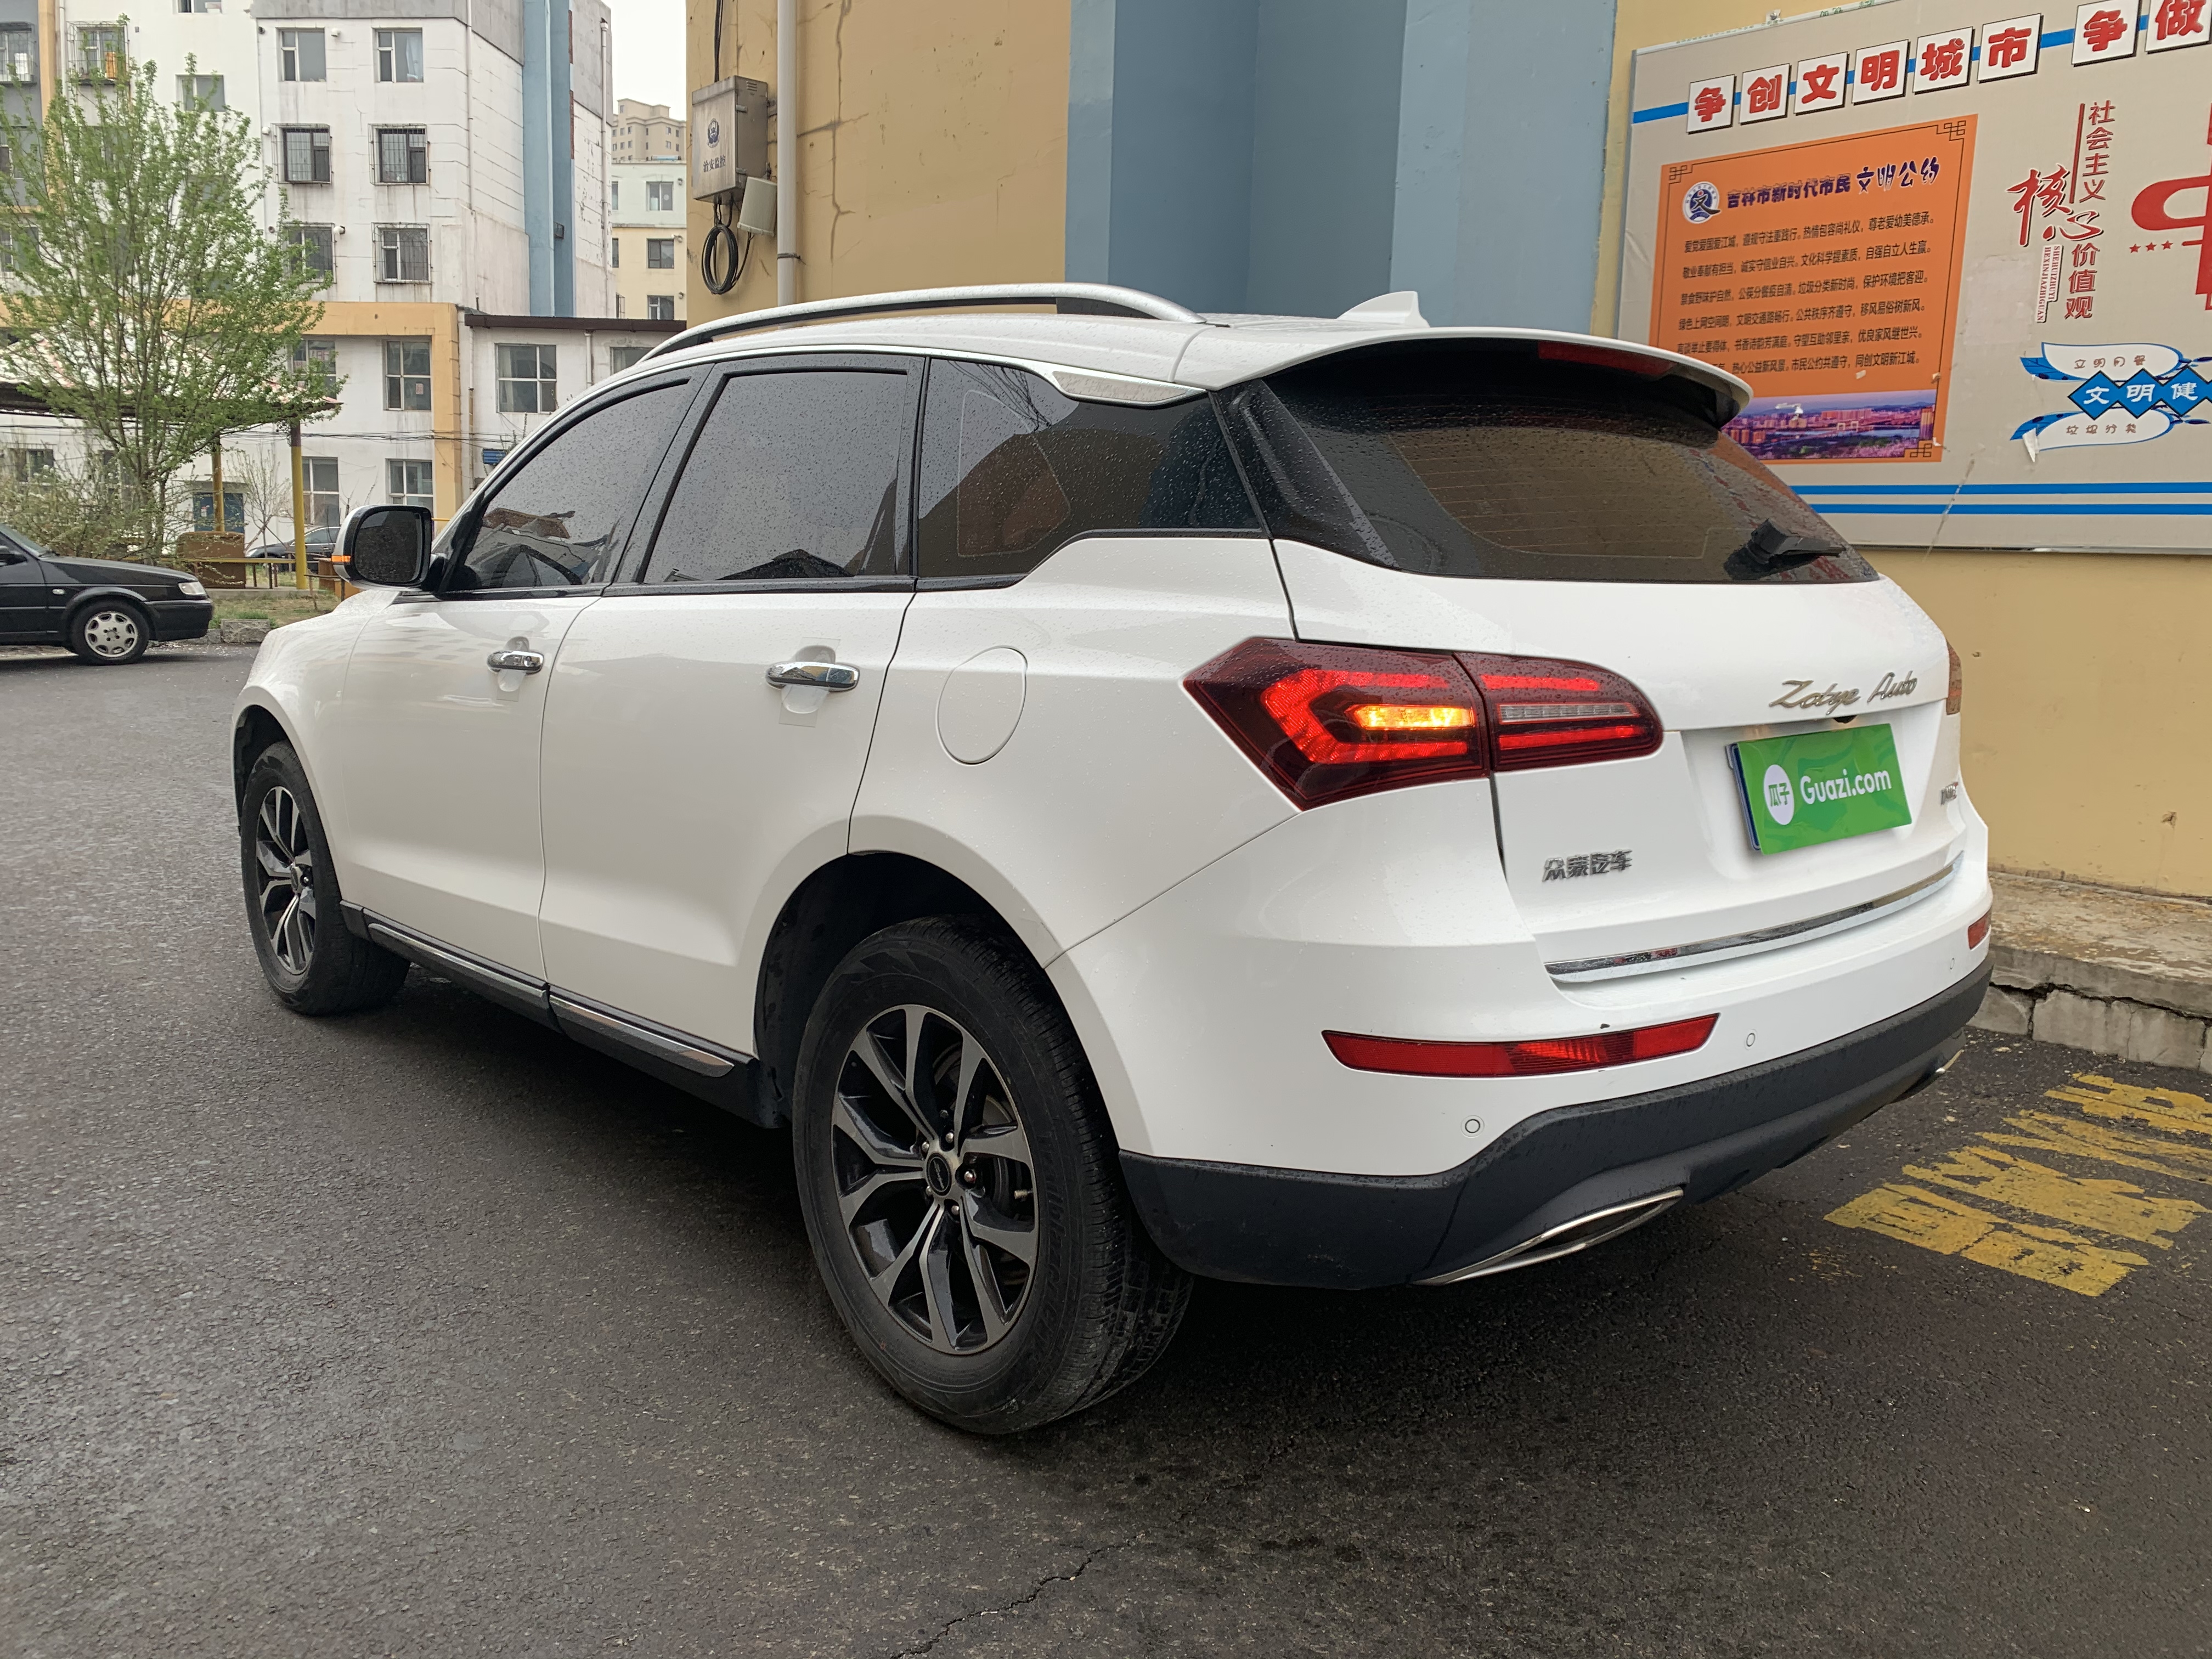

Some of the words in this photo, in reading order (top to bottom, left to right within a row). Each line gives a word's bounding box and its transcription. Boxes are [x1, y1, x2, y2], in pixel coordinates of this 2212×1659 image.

[1695, 27, 2032, 122] 争创文明城市
[703, 154, 726, 173] 治安监控
[2079, 100, 2116, 204] 社会主义
[1856, 156, 1940, 195] 文明公约
[2006, 163, 2104, 247] 核心
[2037, 247, 2051, 320] HEXINJIAZHIGUAN
[2048, 246, 2060, 300] SHEHUIZHUYI
[2064, 242, 2100, 319] 价值观
[2083, 382, 2198, 404] 文明健
[2066, 424, 2137, 435] 垃圾分类
[1769, 680, 1861, 716] Zotye
[1867, 670, 1918, 704] Auto
[1768, 782, 1790, 806] 瓜子
[1800, 768, 1892, 804] Guazi.com
